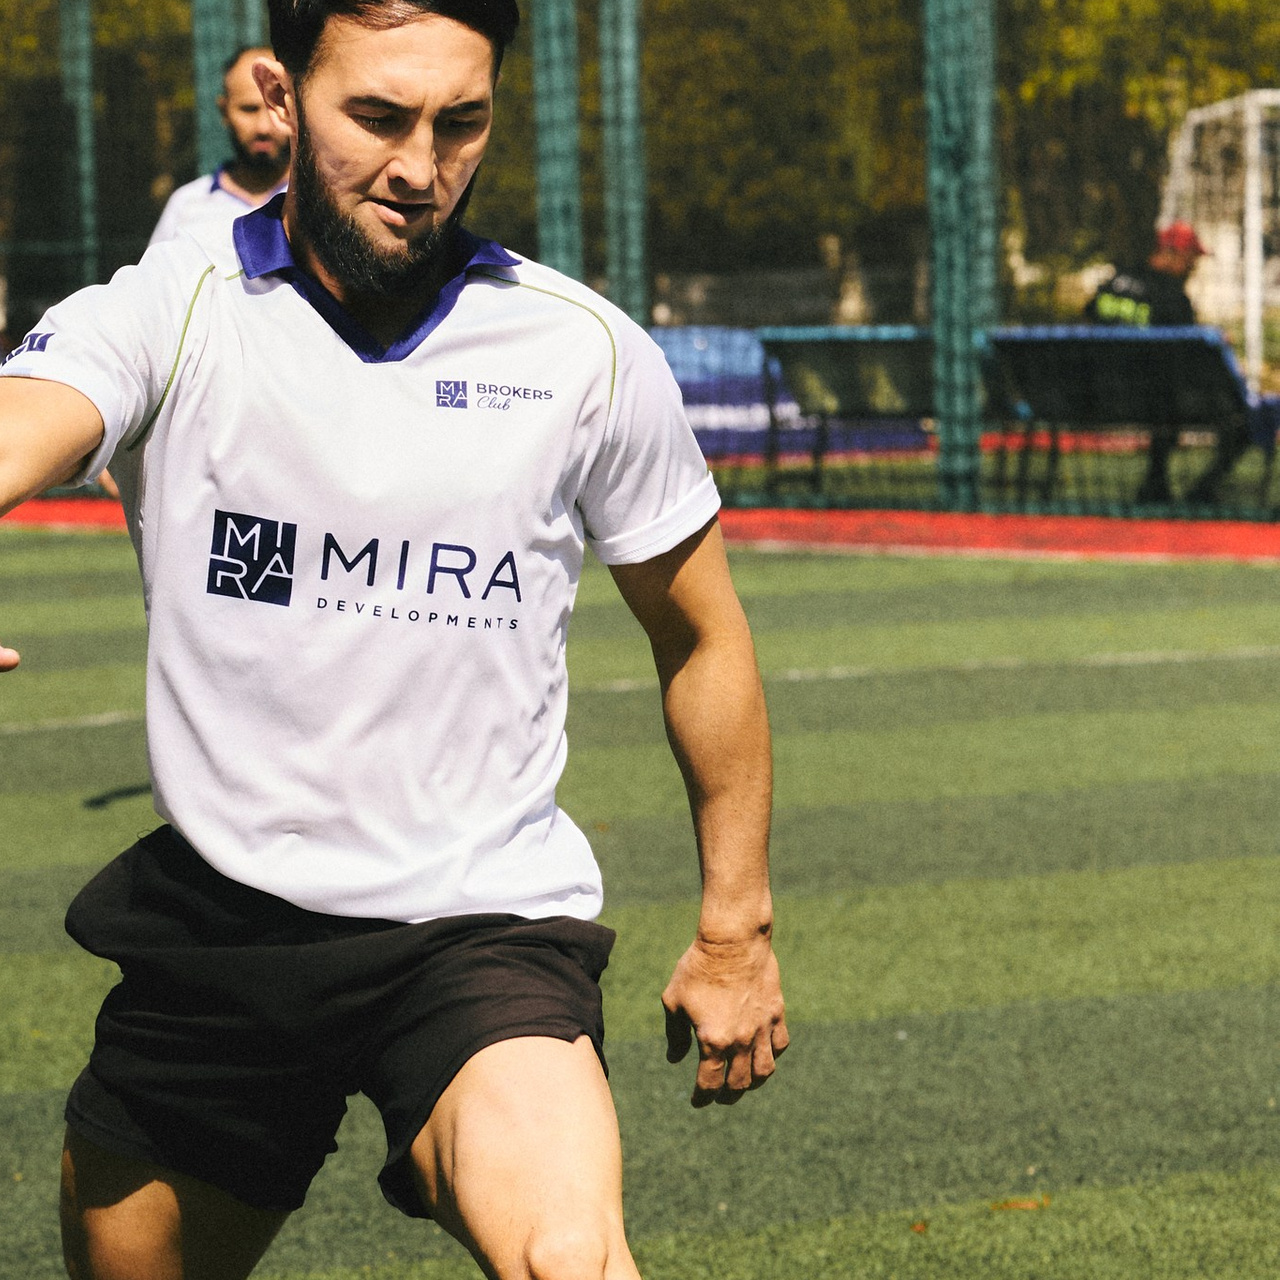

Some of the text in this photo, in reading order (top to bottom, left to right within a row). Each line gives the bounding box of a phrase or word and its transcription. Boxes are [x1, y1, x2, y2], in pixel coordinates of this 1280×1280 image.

[476, 383, 553, 400] BROKERS
[476, 395, 511, 411] Club
[320, 532, 522, 603] MIRA
[316, 597, 519, 630] DEVELOPMENTS
